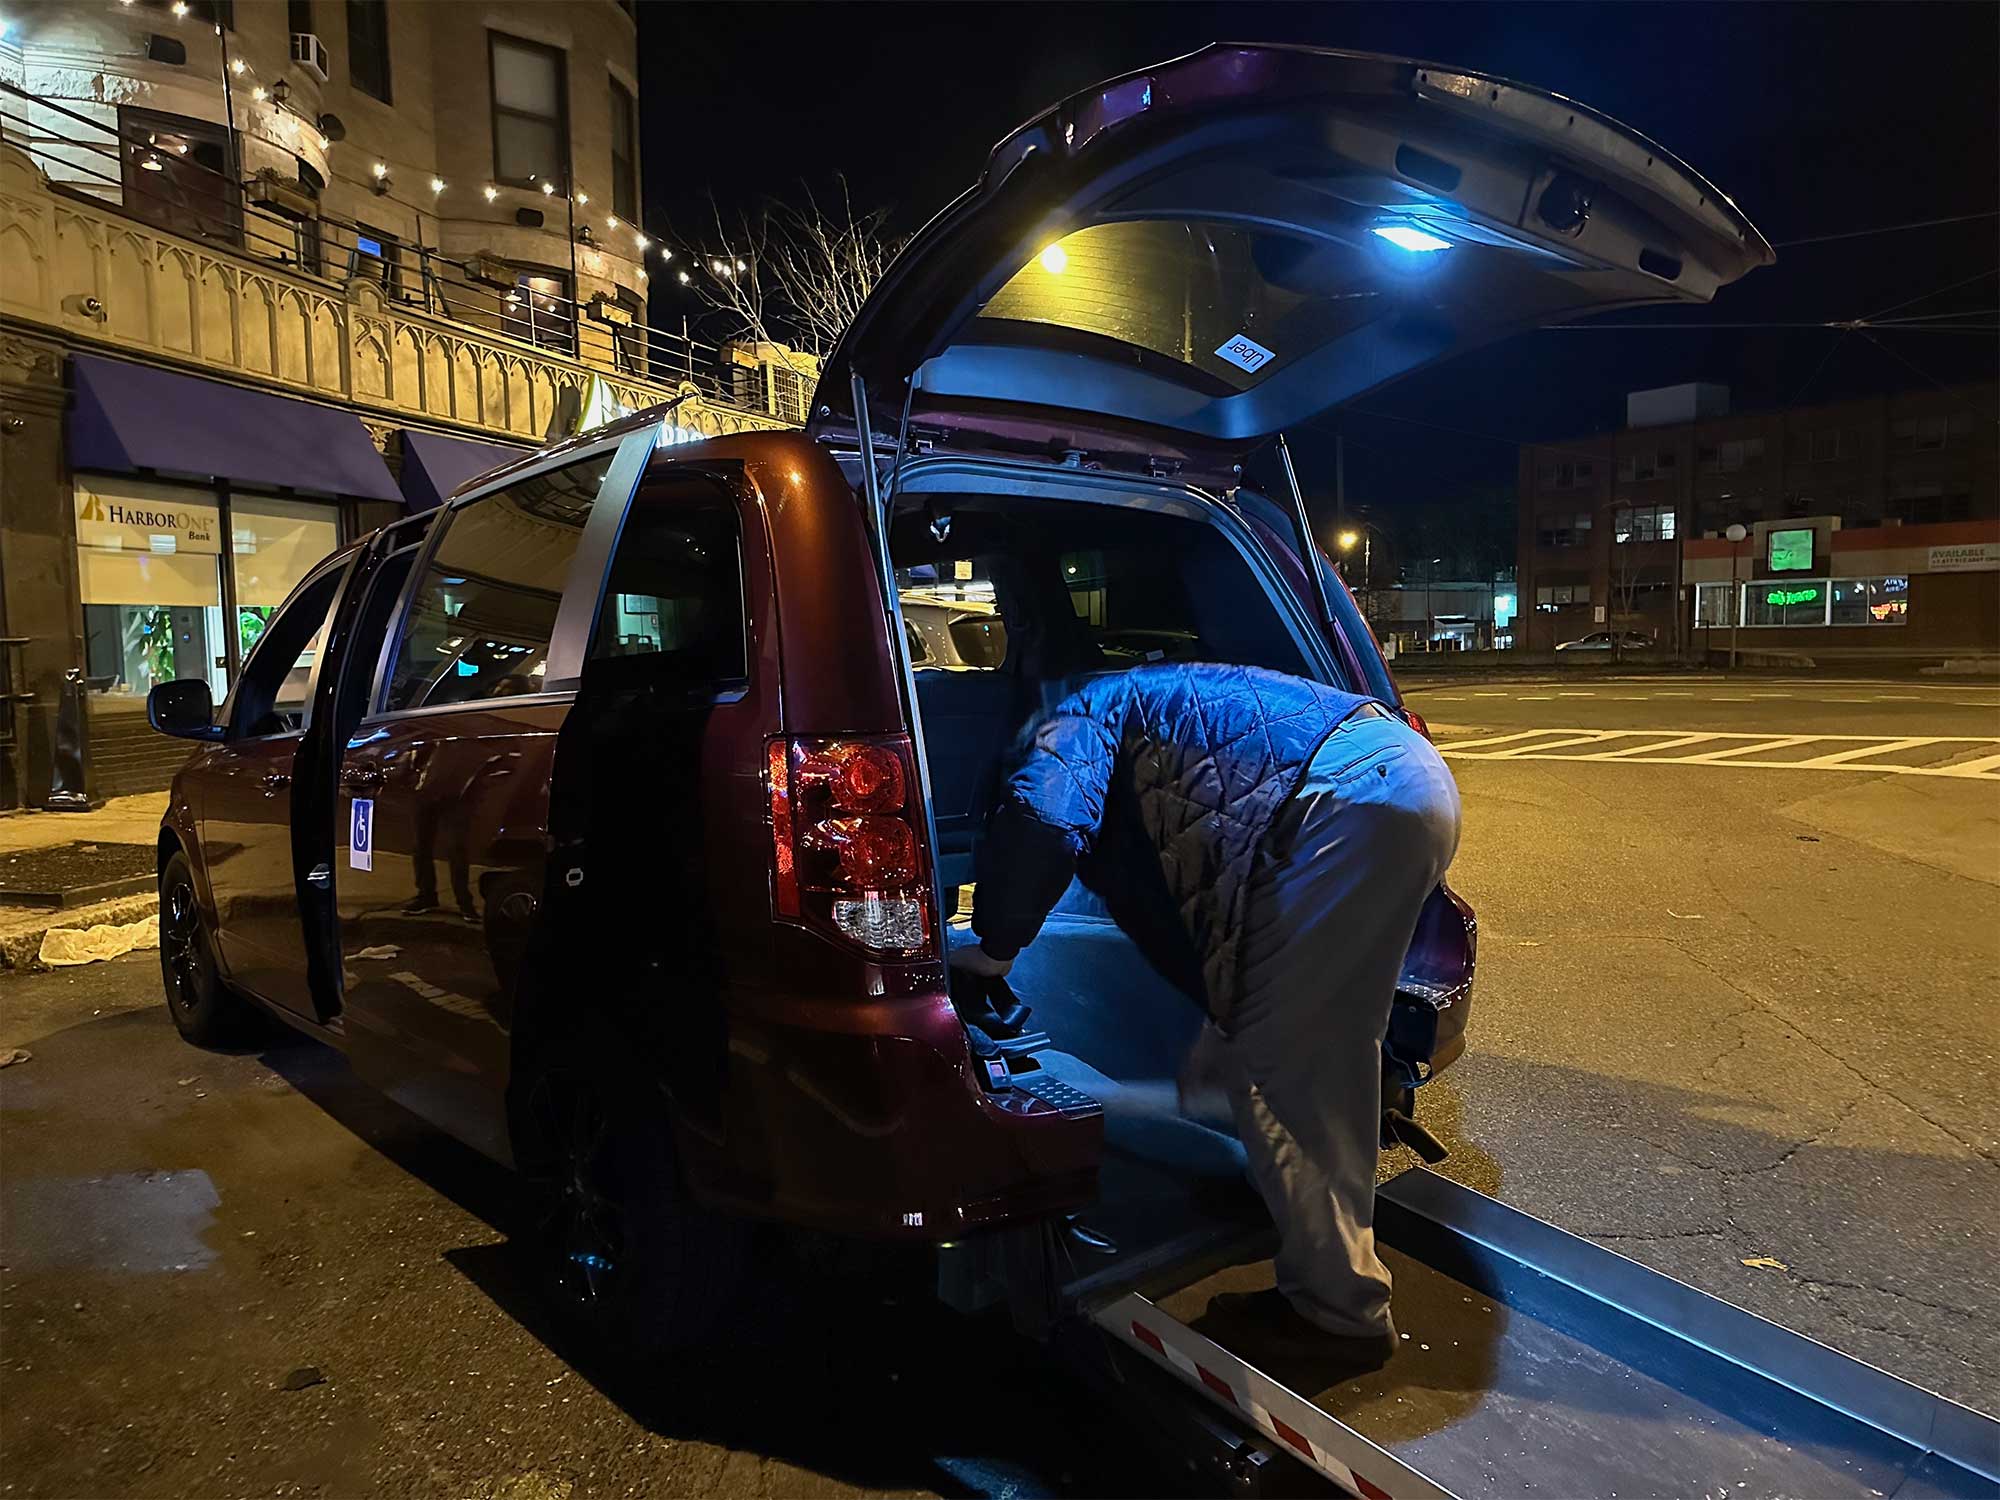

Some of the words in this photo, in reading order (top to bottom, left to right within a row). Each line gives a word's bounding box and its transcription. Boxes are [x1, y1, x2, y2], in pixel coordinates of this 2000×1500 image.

[1227, 341, 1265, 367] Uber
[188, 531, 211, 541] Bank
[1931, 549, 1985, 558] AVAILABLE
